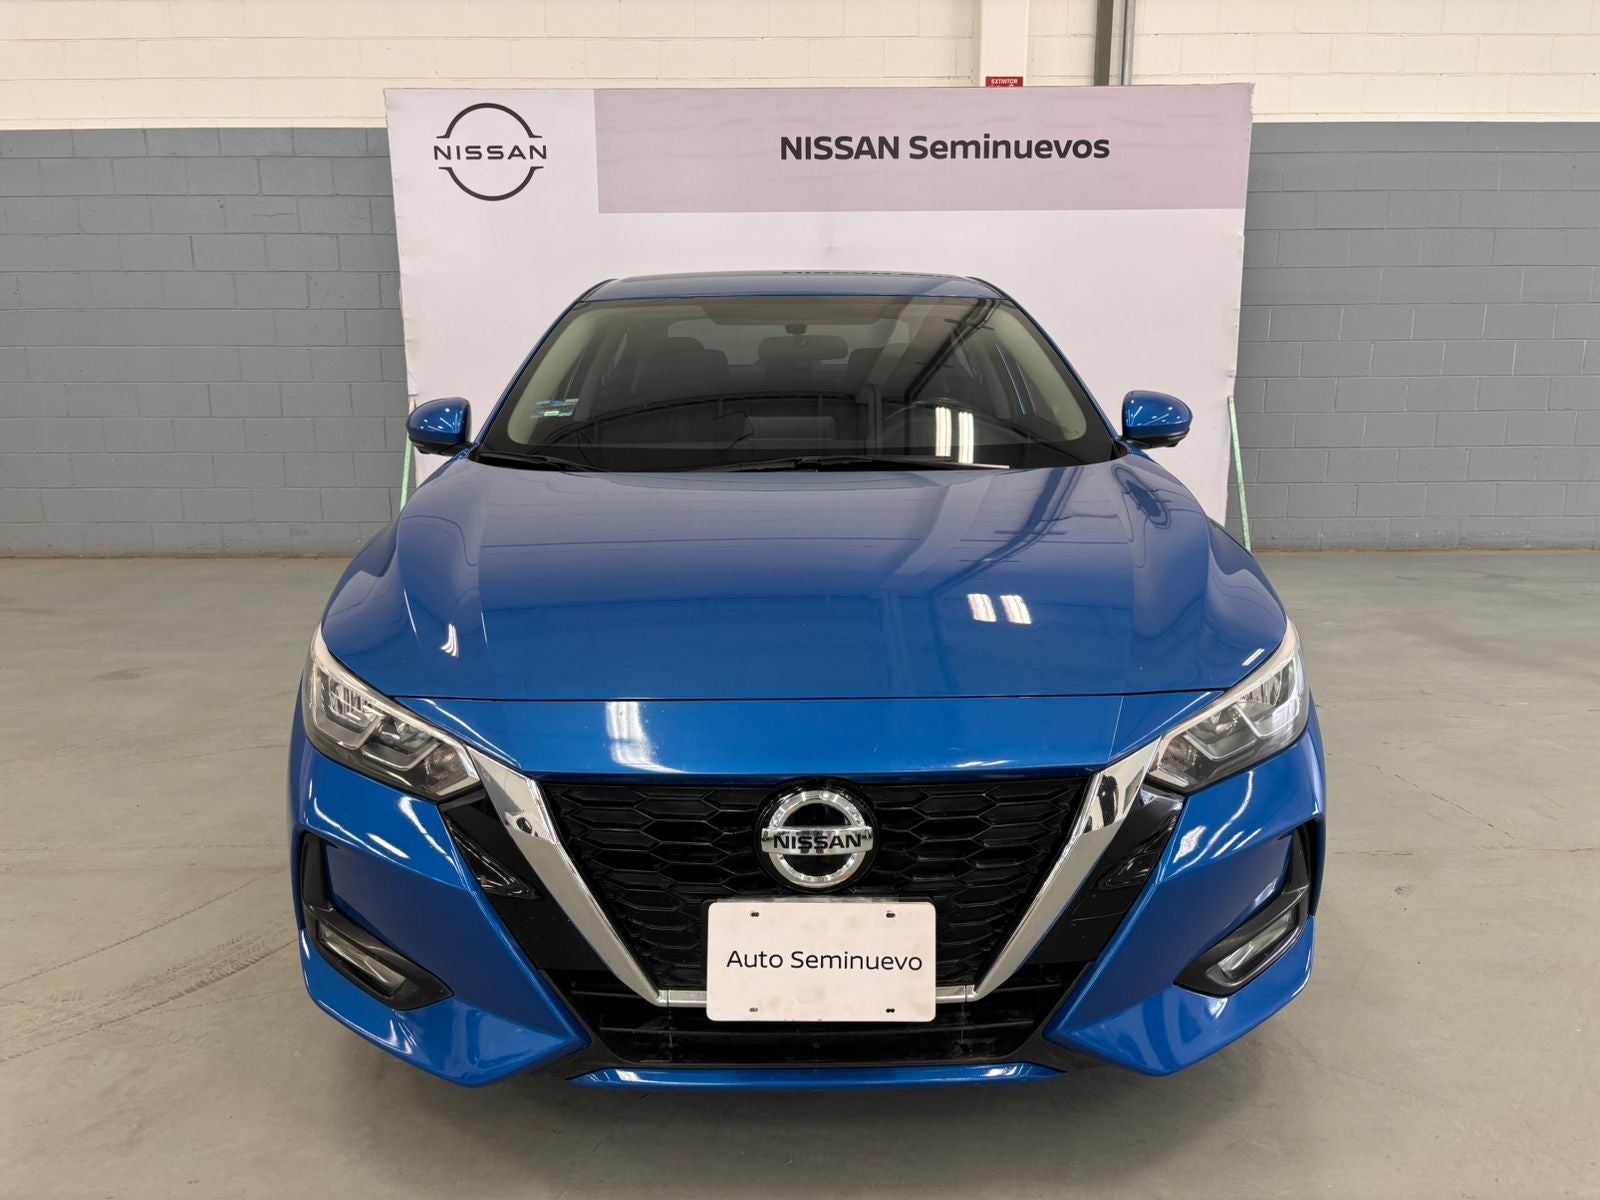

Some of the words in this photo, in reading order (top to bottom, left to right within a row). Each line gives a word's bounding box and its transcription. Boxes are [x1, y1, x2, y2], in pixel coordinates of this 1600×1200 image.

[433, 145, 547, 160] NISSAN
[780, 136, 900, 160] NISSAN
[909, 133, 1111, 160] Seminuevos
[773, 834, 862, 850] NISSAN
[726, 950, 784, 969] Auto
[790, 951, 923, 971] Seminuevo
